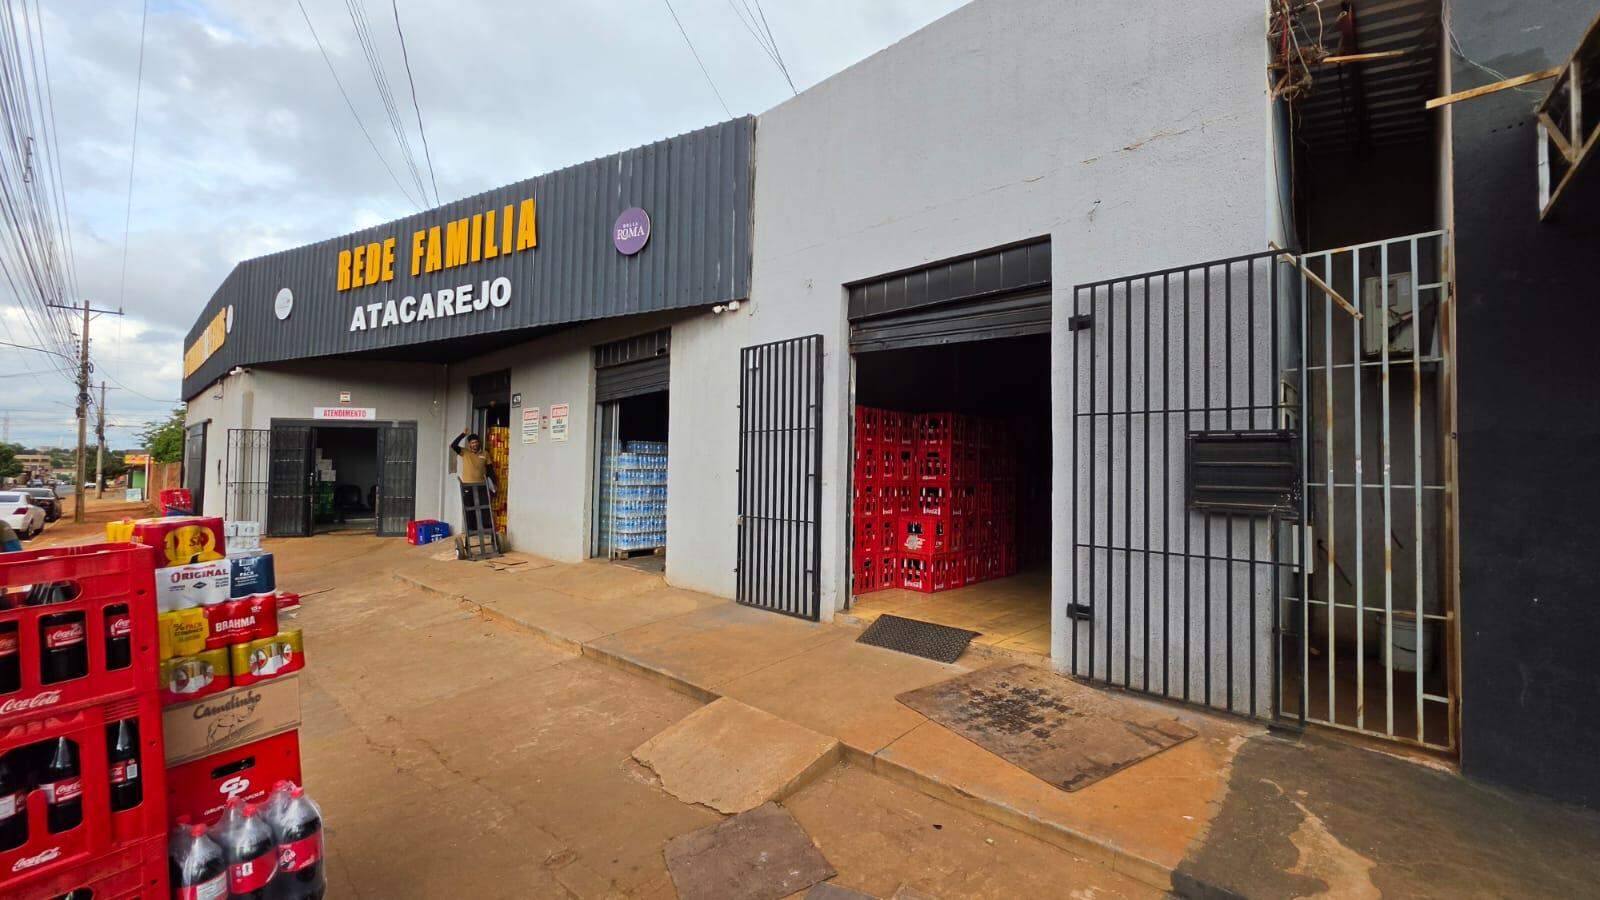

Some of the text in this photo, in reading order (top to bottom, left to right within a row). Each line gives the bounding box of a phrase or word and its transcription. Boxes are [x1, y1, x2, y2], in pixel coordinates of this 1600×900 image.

[616, 225, 646, 241] ROMA
[337, 198, 537, 292] REDE FAMILIA
[350, 276, 512, 332] ATACAREJO
[323, 409, 367, 418] ATENDIMENTO
[170, 568, 229, 584] ORIGINAL
[215, 615, 256, 632] BRAHMA
